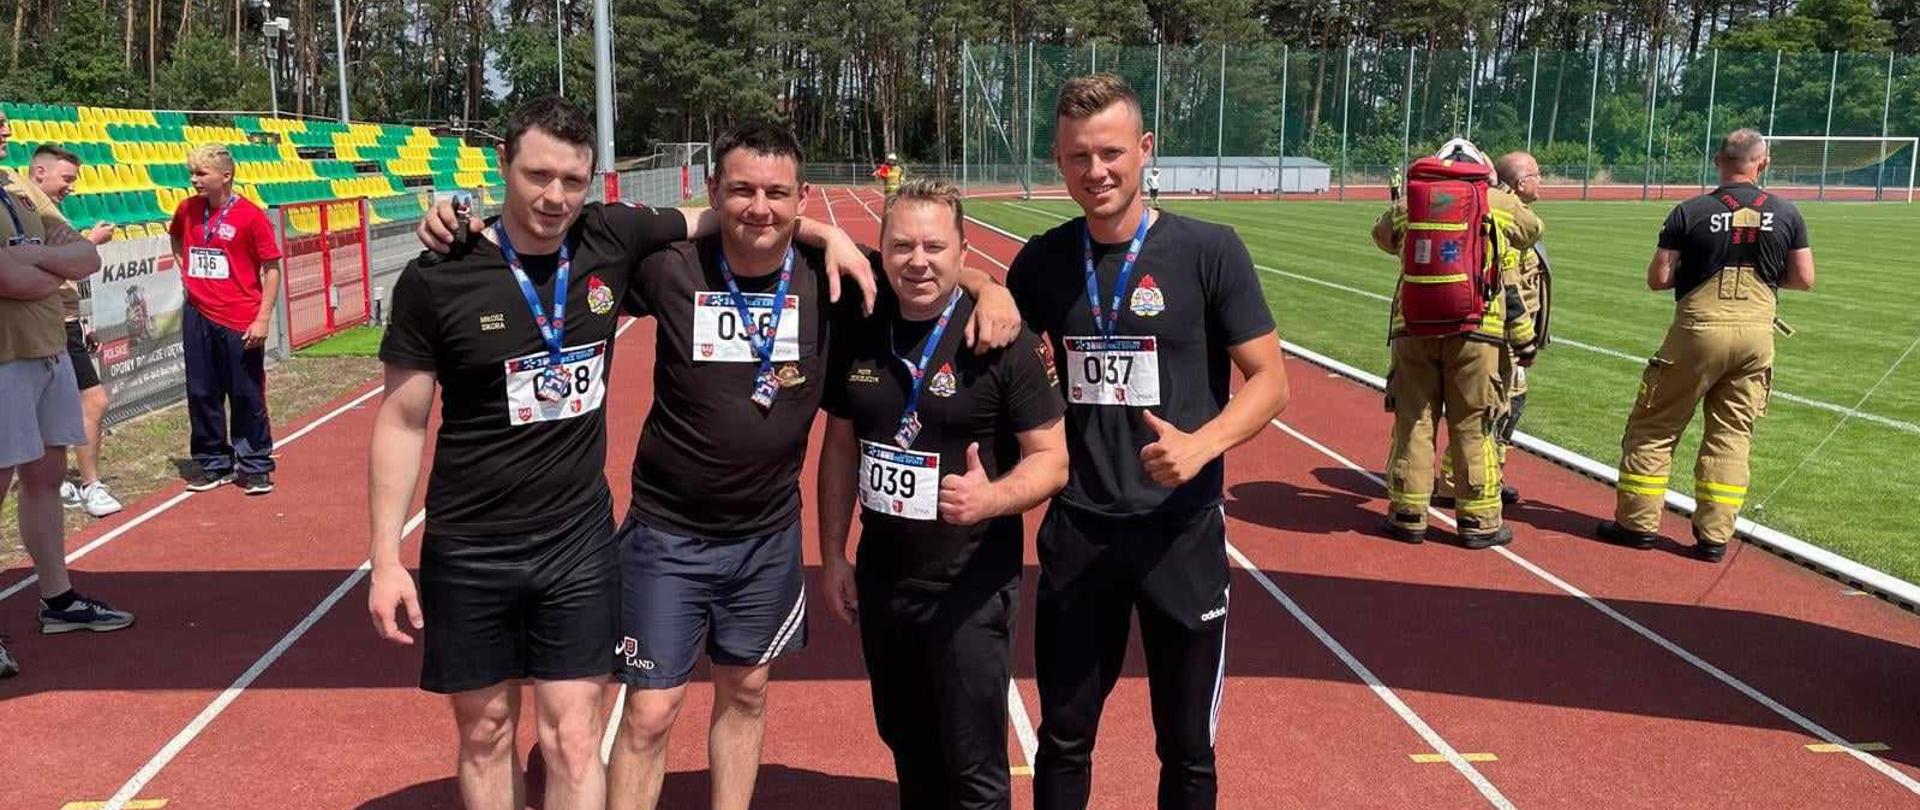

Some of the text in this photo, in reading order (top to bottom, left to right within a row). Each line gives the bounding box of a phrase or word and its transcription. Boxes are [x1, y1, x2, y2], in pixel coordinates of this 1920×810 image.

[1710, 211, 1774, 233] STŻ
[102, 256, 156, 284] KABAT
[110, 358, 135, 377] OPONY
[1084, 356, 1134, 385] 037
[870, 463, 916, 499] 039
[625, 656, 655, 670] LAND
